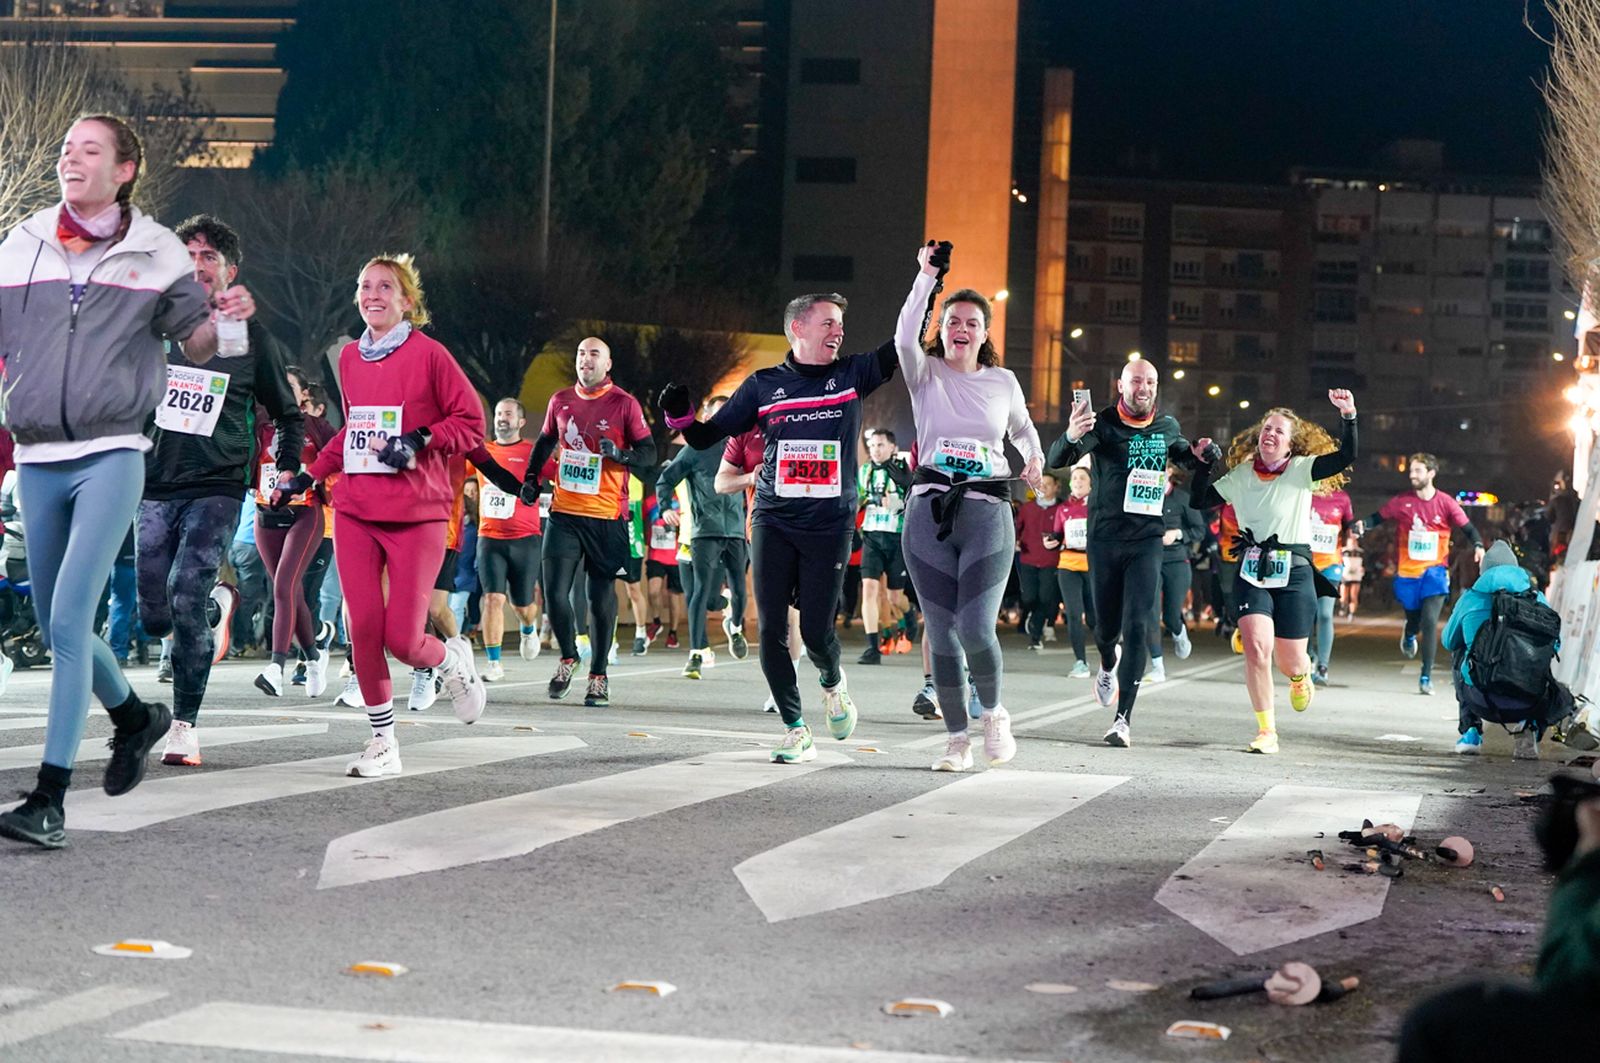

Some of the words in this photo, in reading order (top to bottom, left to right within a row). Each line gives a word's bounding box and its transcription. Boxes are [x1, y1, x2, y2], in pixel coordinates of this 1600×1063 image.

[174, 373, 195, 382] NOCHE
[167, 388, 215, 414] 2628
[1128, 440, 1145, 450] XIX
[797, 452, 818, 460] ANTÓN
[563, 464, 595, 481] 14043
